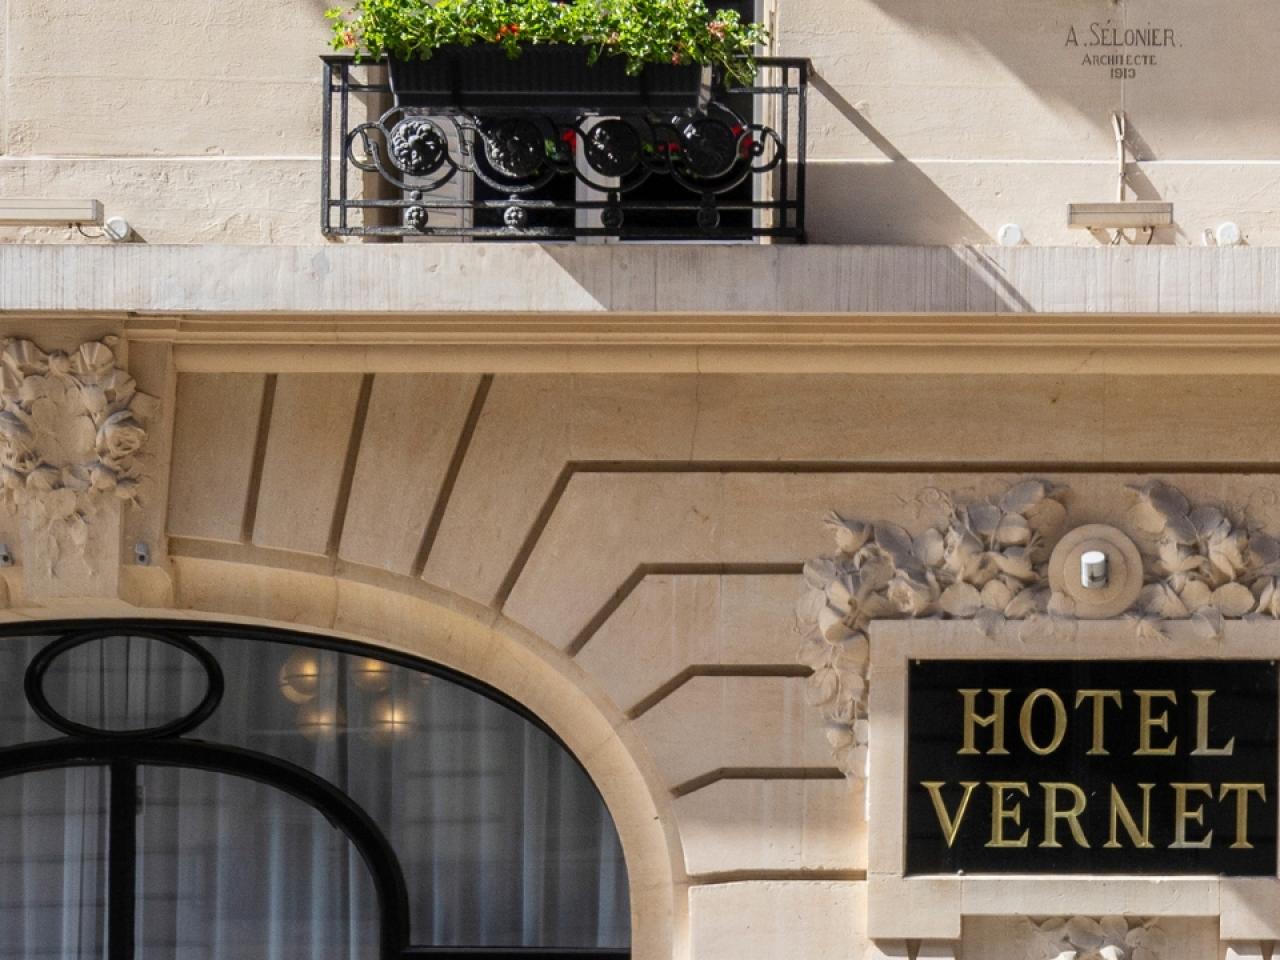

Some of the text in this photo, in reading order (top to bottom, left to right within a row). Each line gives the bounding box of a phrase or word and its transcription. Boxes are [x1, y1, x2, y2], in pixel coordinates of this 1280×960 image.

[1110, 67, 1137, 80] 1913
[956, 688, 1235, 757] HOTEL
[920, 781, 1266, 849] VERNET
